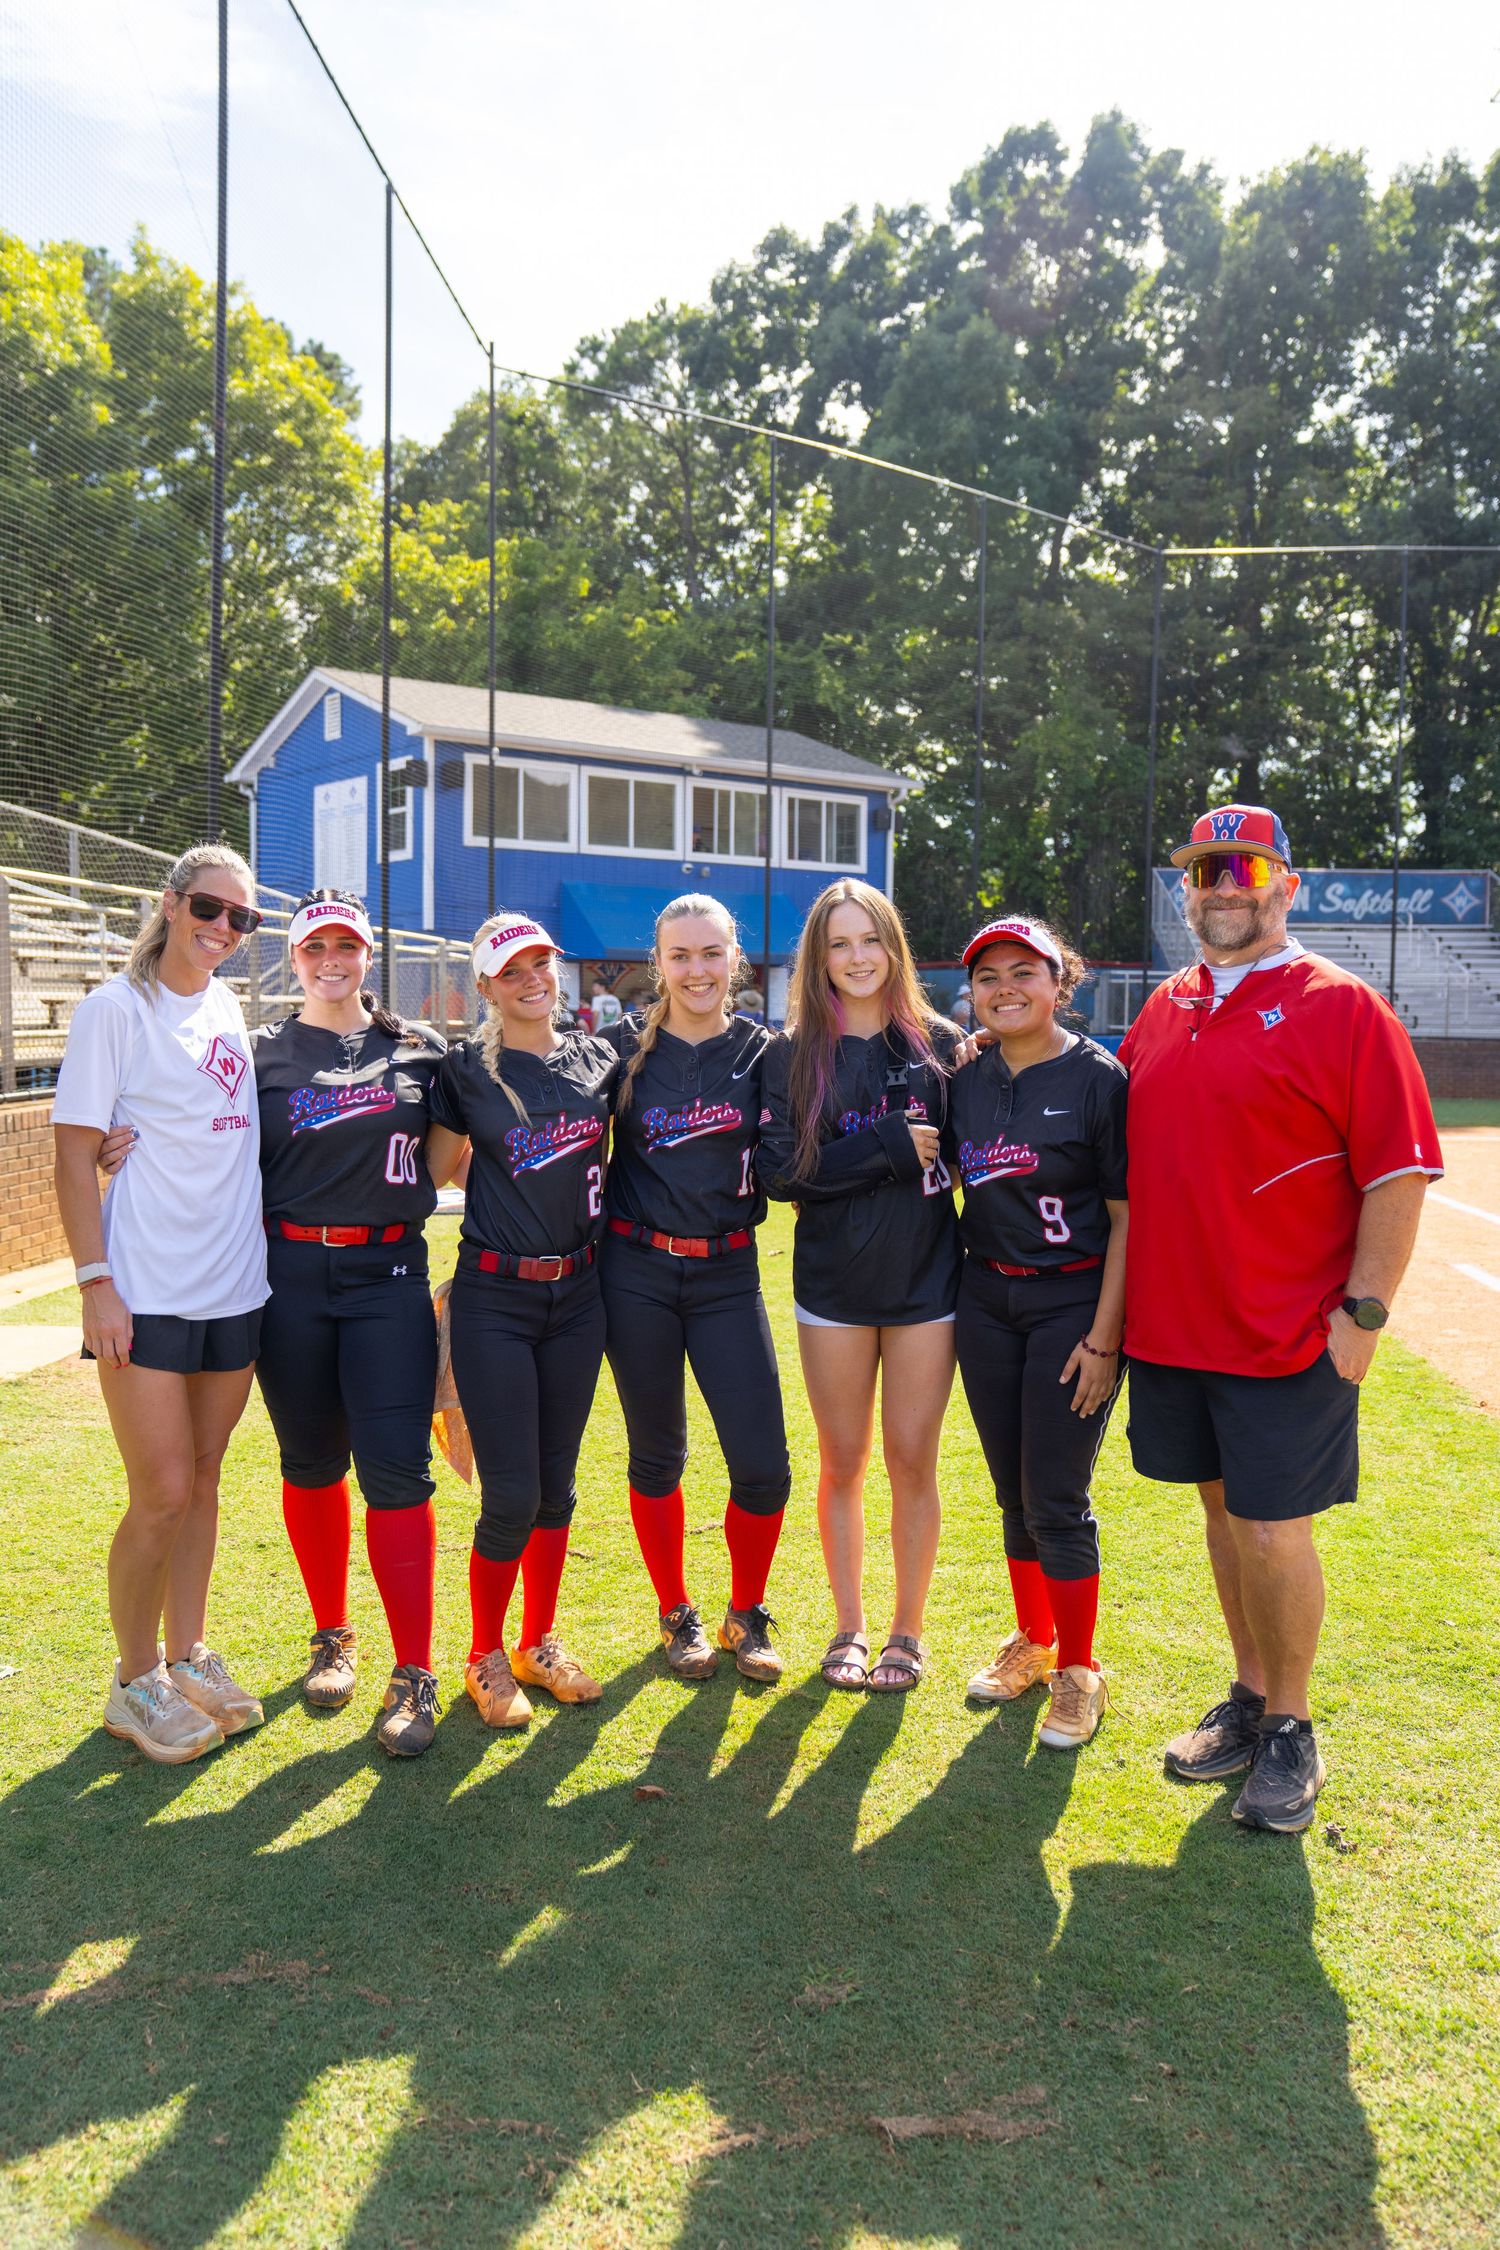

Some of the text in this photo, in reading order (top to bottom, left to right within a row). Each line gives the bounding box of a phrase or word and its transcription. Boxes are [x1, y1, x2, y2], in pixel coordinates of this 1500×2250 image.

[1209, 812, 1247, 841] W
[306, 905, 357, 921] RAIDERS
[1318, 881, 1434, 921] Softball
[490, 924, 540, 950] RAIDERS
[217, 1057, 236, 1076] W
[288, 1081, 396, 1122] Raiders
[641, 1097, 742, 1139] Raiders
[503, 1111, 604, 1162] Raiders
[960, 1133, 1039, 1175] Raiders
[384, 1132, 421, 1185] 00
[1037, 1195, 1072, 1243] 9
